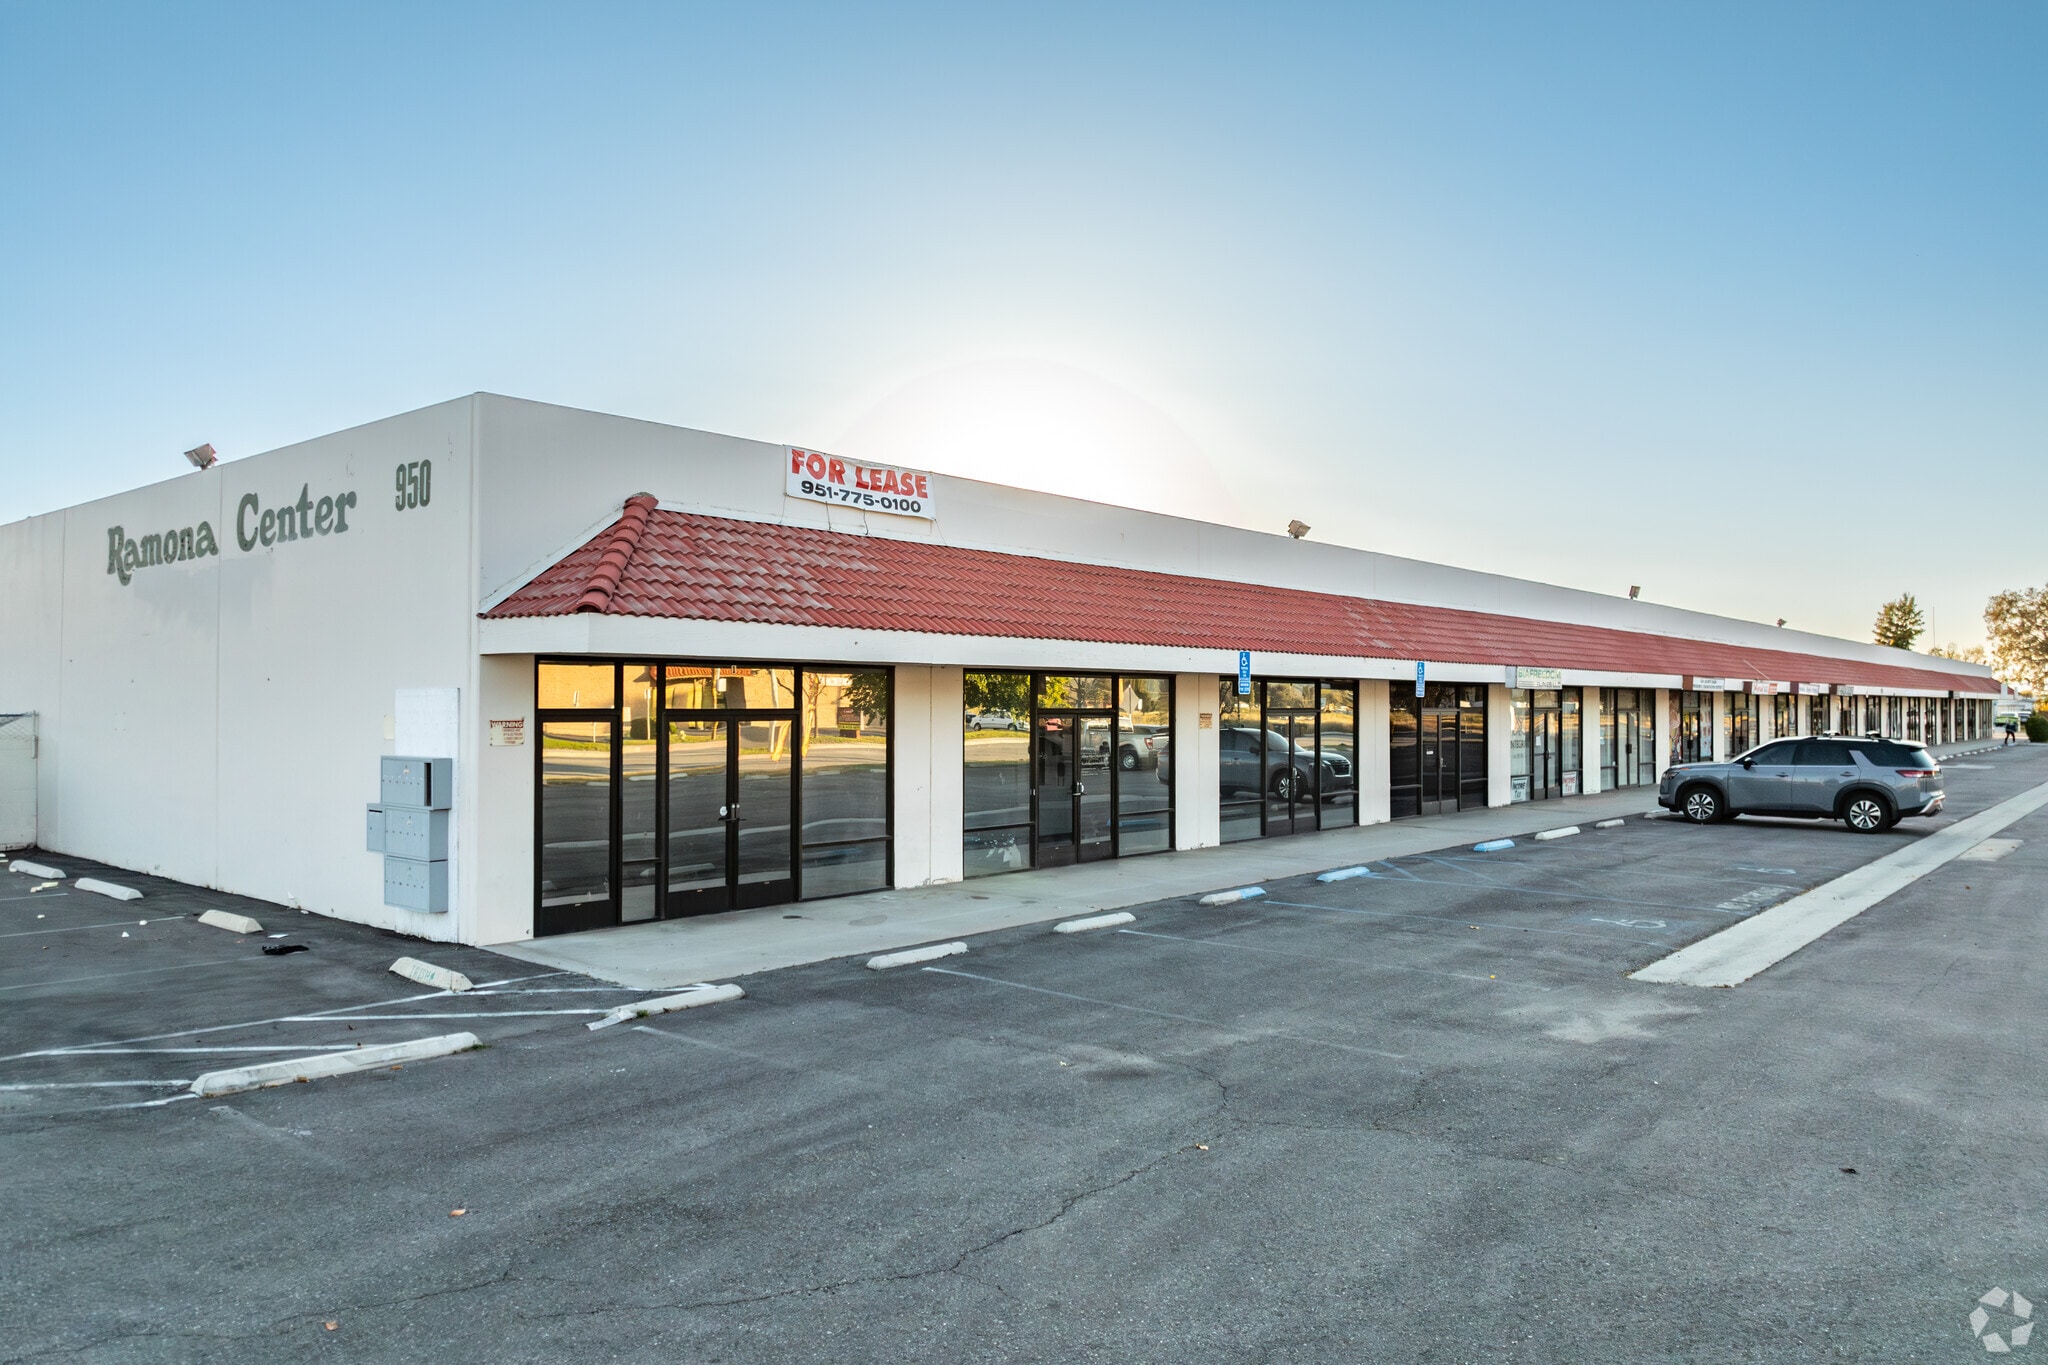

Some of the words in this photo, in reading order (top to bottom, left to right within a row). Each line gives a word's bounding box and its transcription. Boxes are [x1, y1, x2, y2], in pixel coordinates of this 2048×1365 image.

[395, 459, 432, 512] 950
[791, 448, 846, 485] FOR
[855, 466, 929, 499] LEASE
[801, 480, 922, 513] 951-775-0100
[106, 520, 219, 586] Ramona
[236, 482, 358, 552] Center
